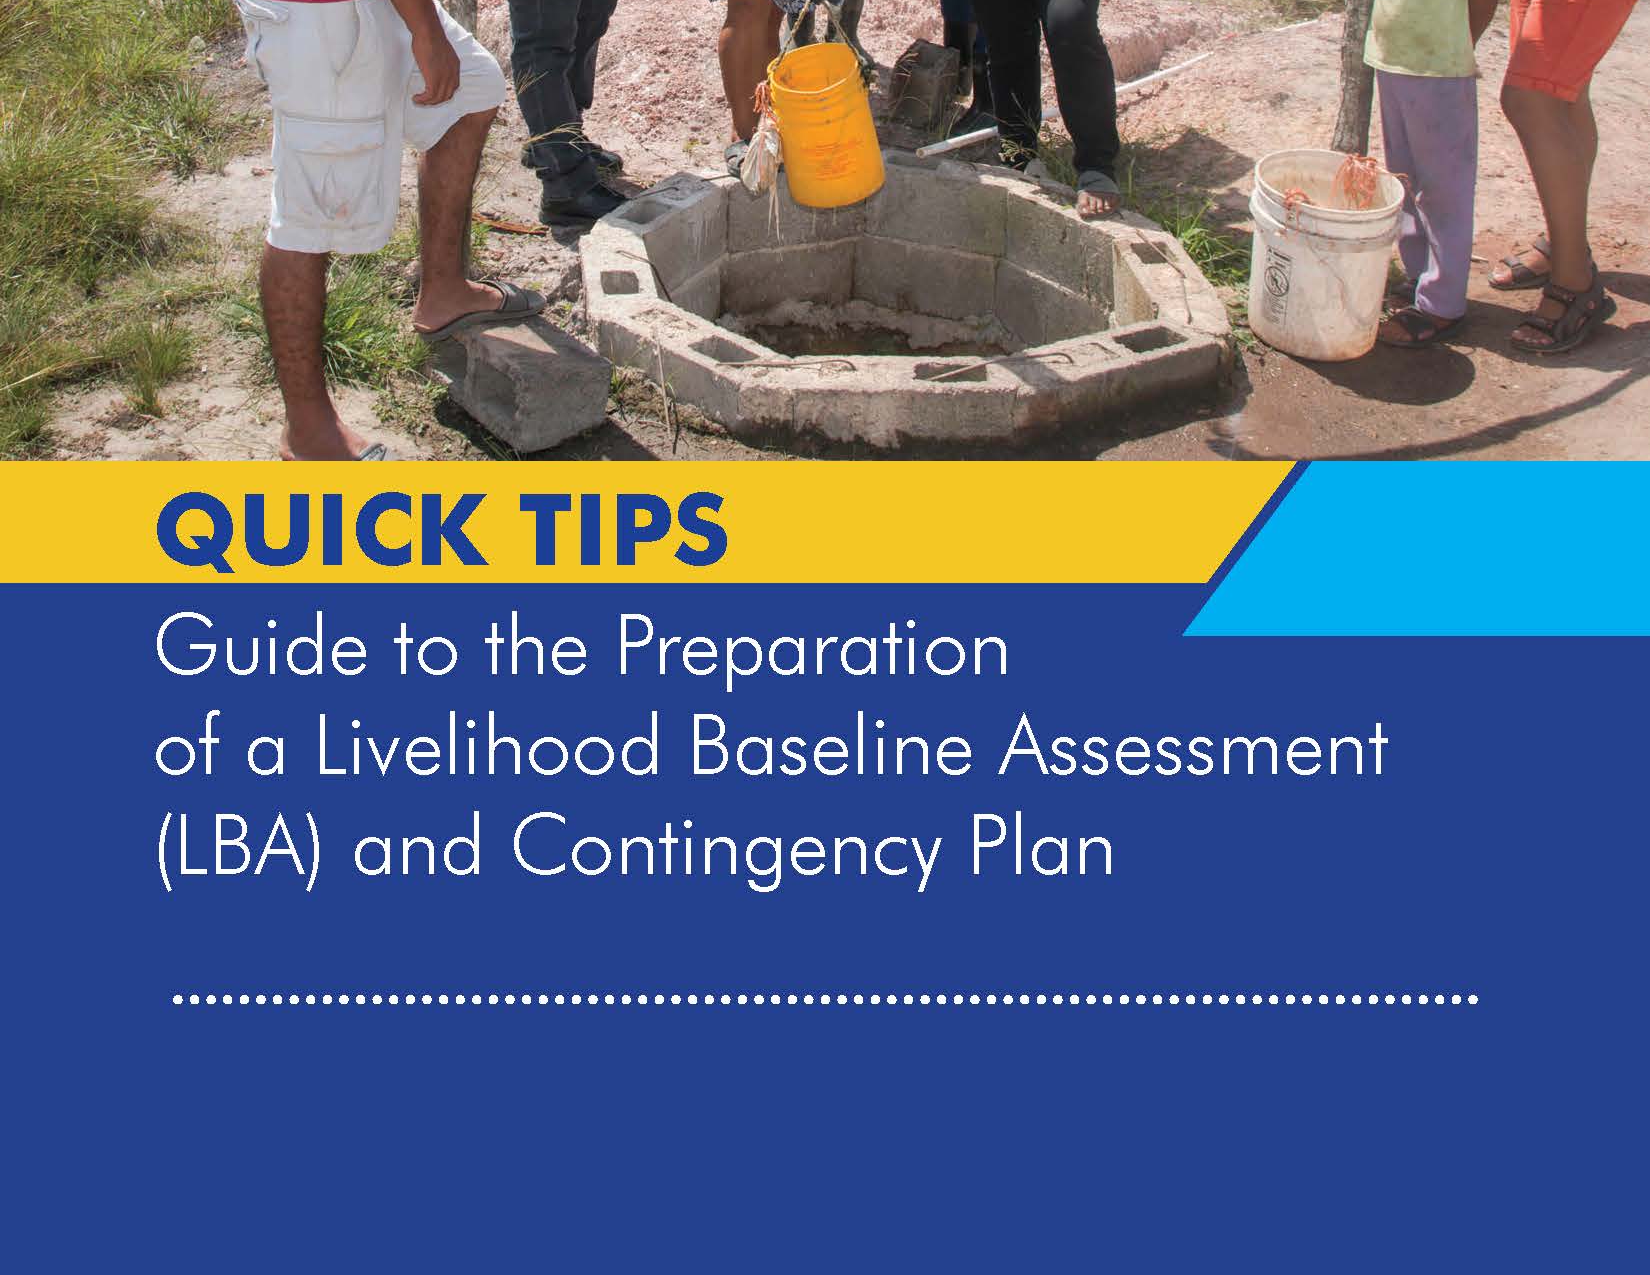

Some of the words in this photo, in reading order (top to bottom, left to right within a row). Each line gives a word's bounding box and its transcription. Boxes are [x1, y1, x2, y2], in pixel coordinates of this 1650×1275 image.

[157, 492, 489, 573] QUICK
[520, 492, 727, 566] TIPS
[157, 611, 366, 675] Guide
[394, 623, 457, 675] to
[485, 611, 586, 675] the
[621, 614, 1006, 692] Preparation
[156, 710, 220, 775] of
[248, 737, 283, 775] a
[320, 711, 657, 776] Livelihood
[694, 711, 971, 775] Baseline
[998, 712, 1388, 775] Assessment
[159, 812, 319, 892] (LBA)
[355, 811, 479, 875] and
[514, 812, 942, 892] Contingency
[974, 811, 1111, 875] Plan
